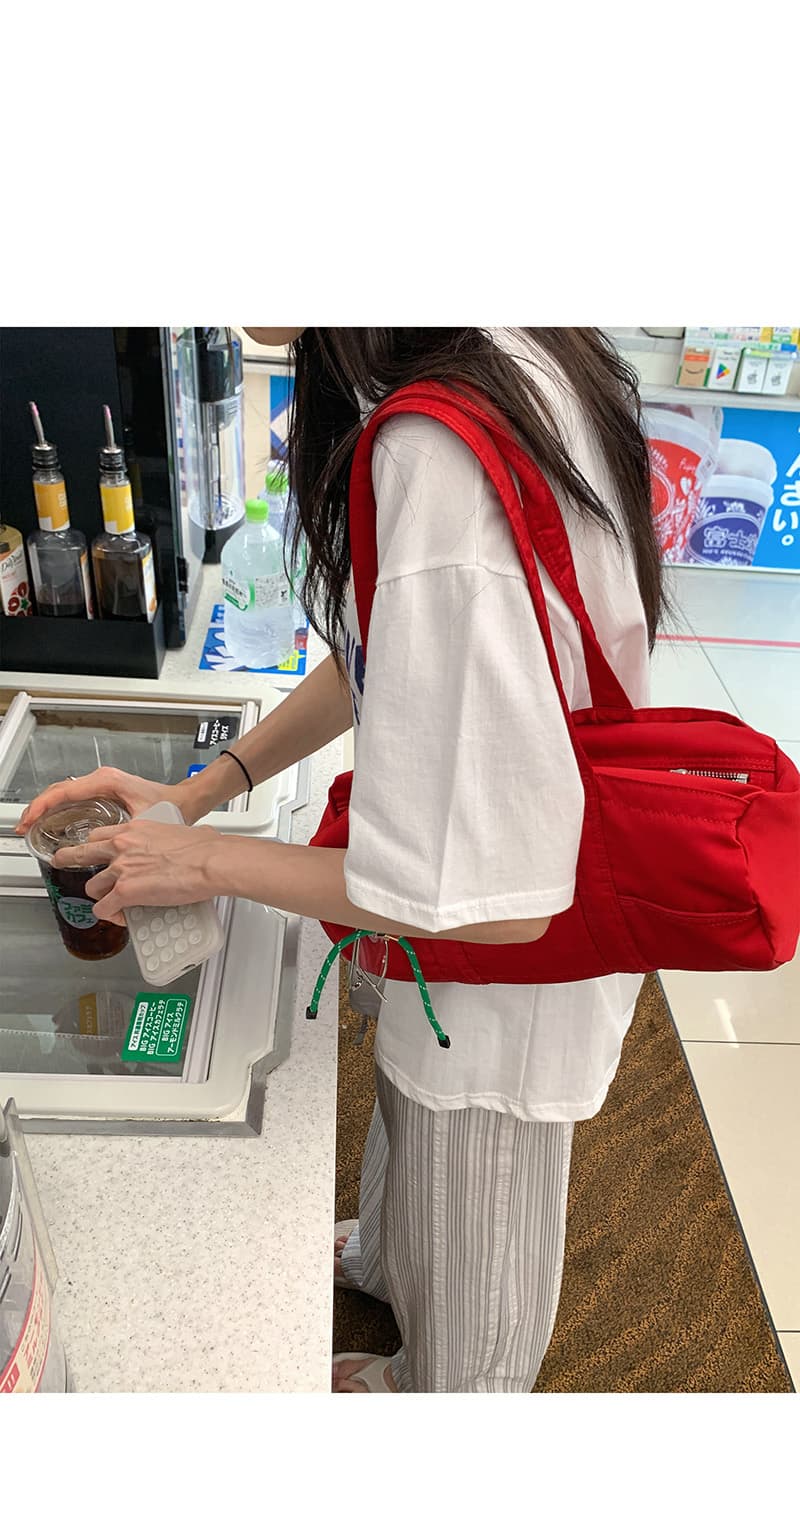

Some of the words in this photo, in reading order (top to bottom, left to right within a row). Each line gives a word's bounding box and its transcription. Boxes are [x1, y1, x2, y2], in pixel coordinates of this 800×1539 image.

[142, 1001, 157, 1038] アイスコーヒー
[162, 1029, 171, 1042] BIG
[140, 1039, 149, 1052] BIG
[147, 1043, 156, 1055] BIG
